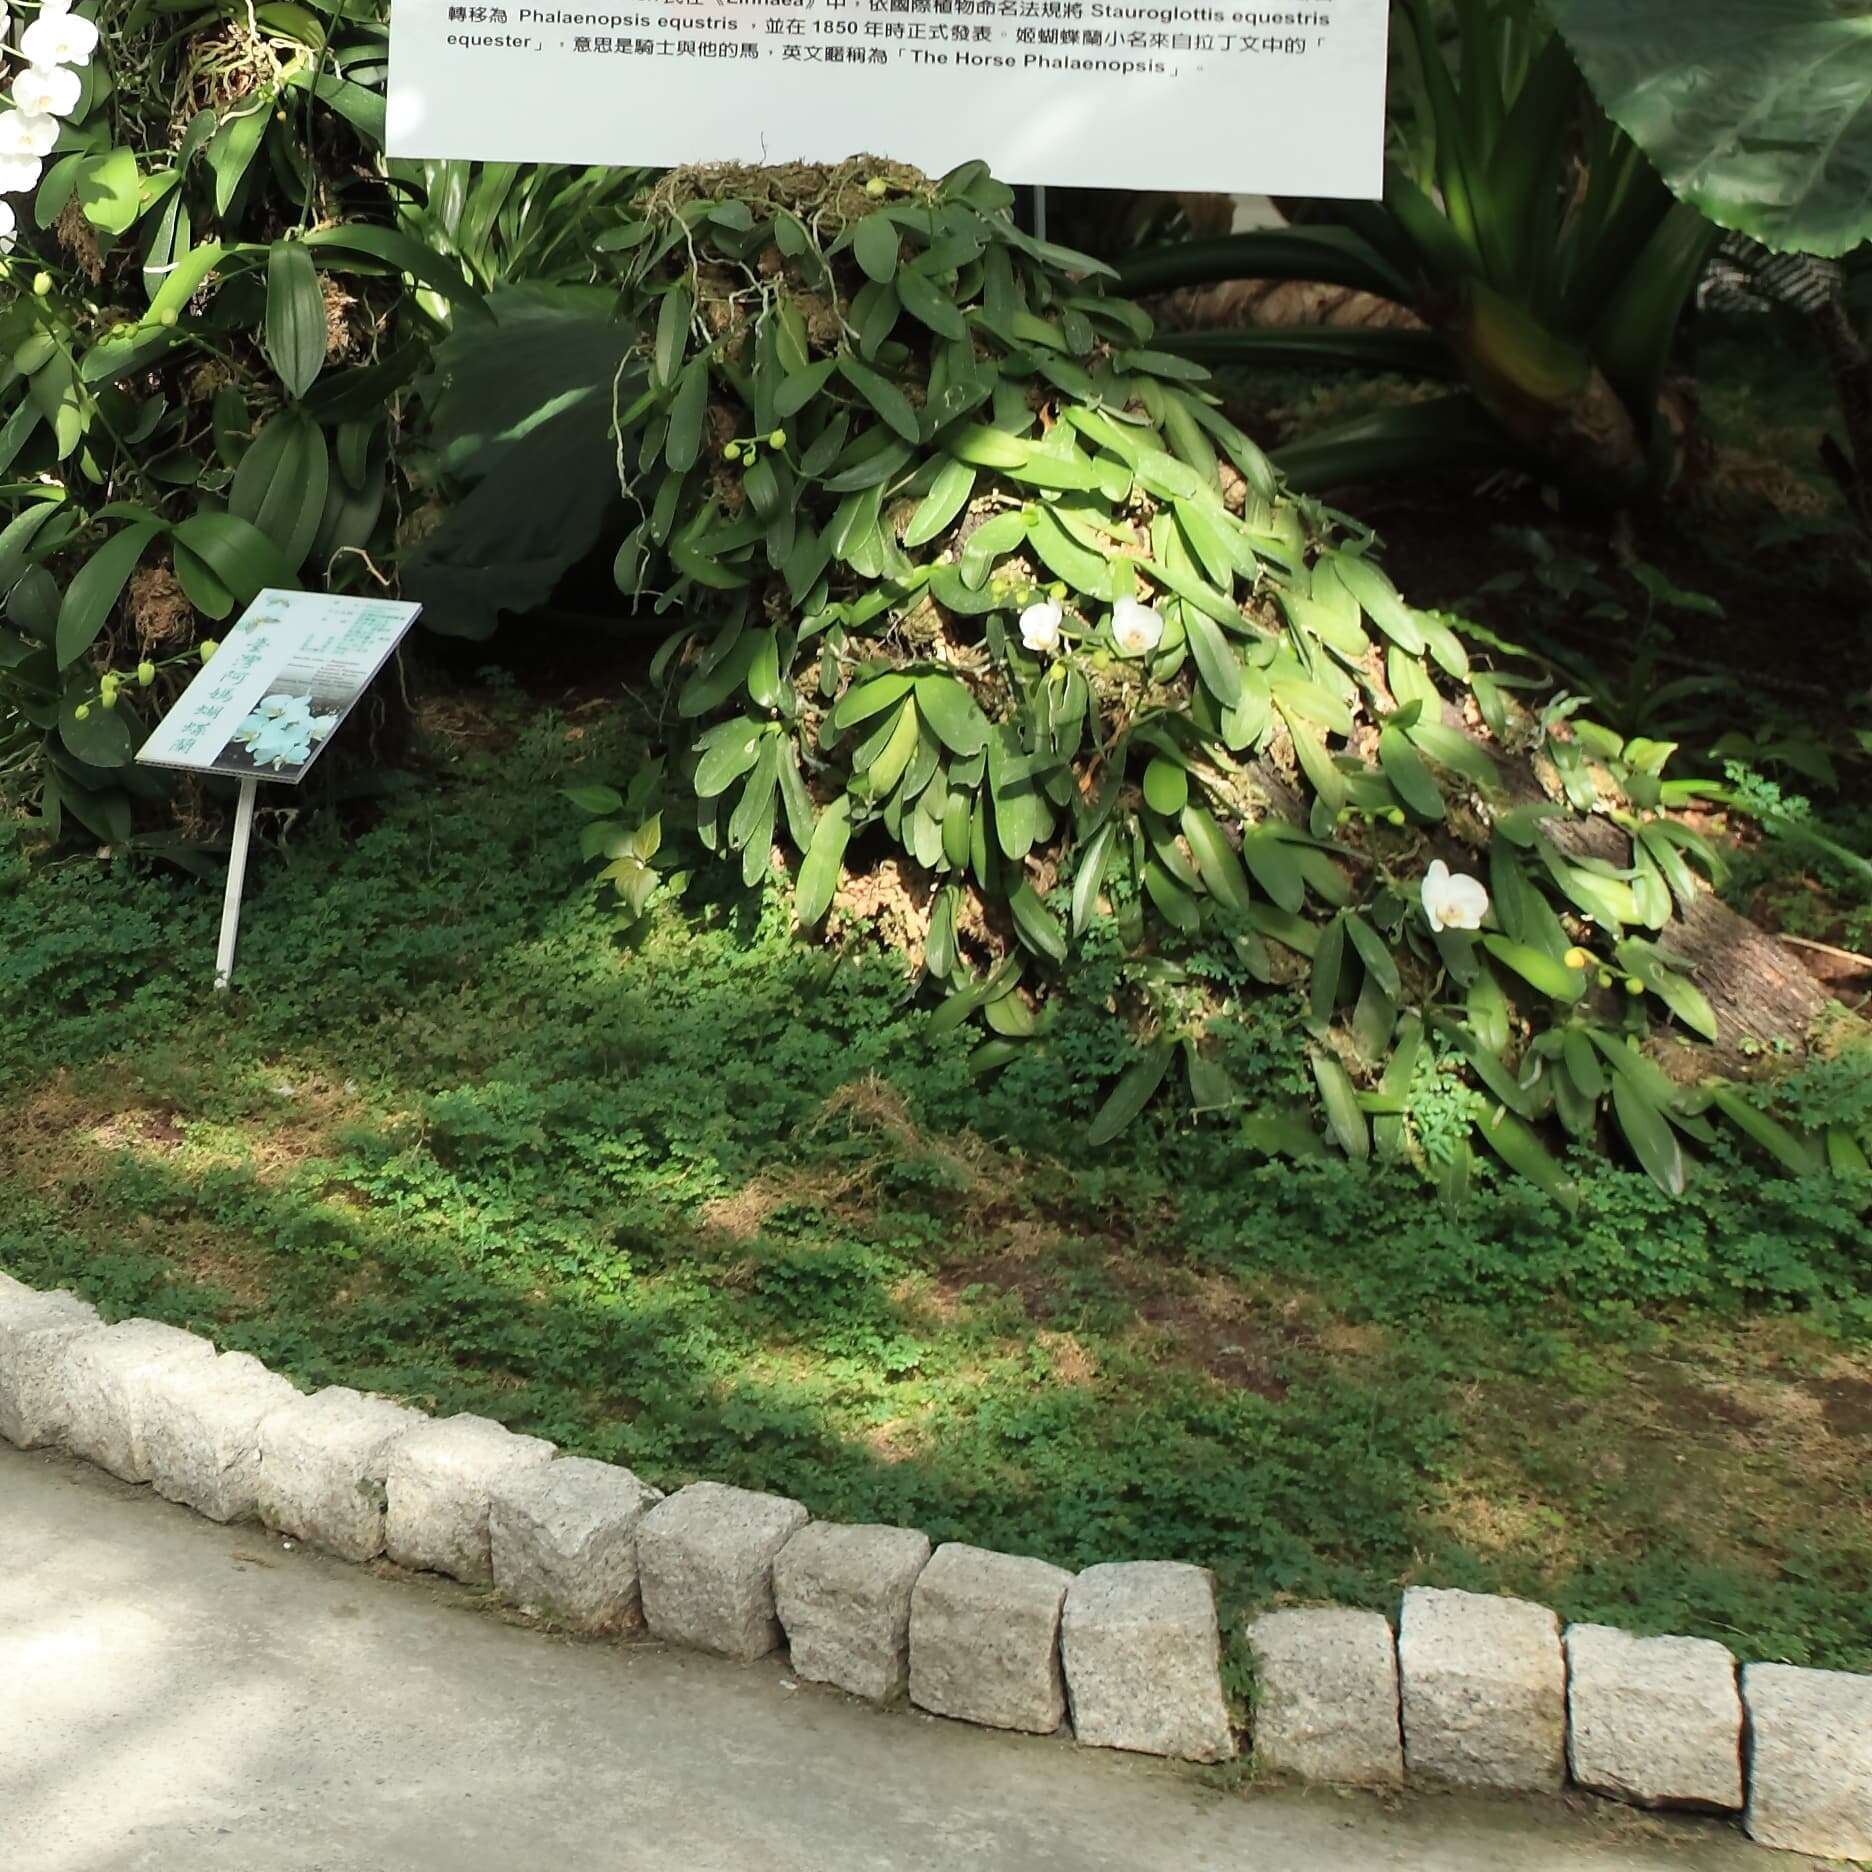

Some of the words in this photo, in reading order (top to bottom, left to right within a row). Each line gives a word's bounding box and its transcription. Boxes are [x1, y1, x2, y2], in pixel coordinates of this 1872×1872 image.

[518, 9, 651, 29] Phalaenopsis
[657, 13, 738, 31] equstris
[813, 20, 858, 35] 1850
[1090, 3, 1224, 24] Stauroglottis
[1232, 10, 1330, 28] equestris
[956, 51, 1016, 68] Horse
